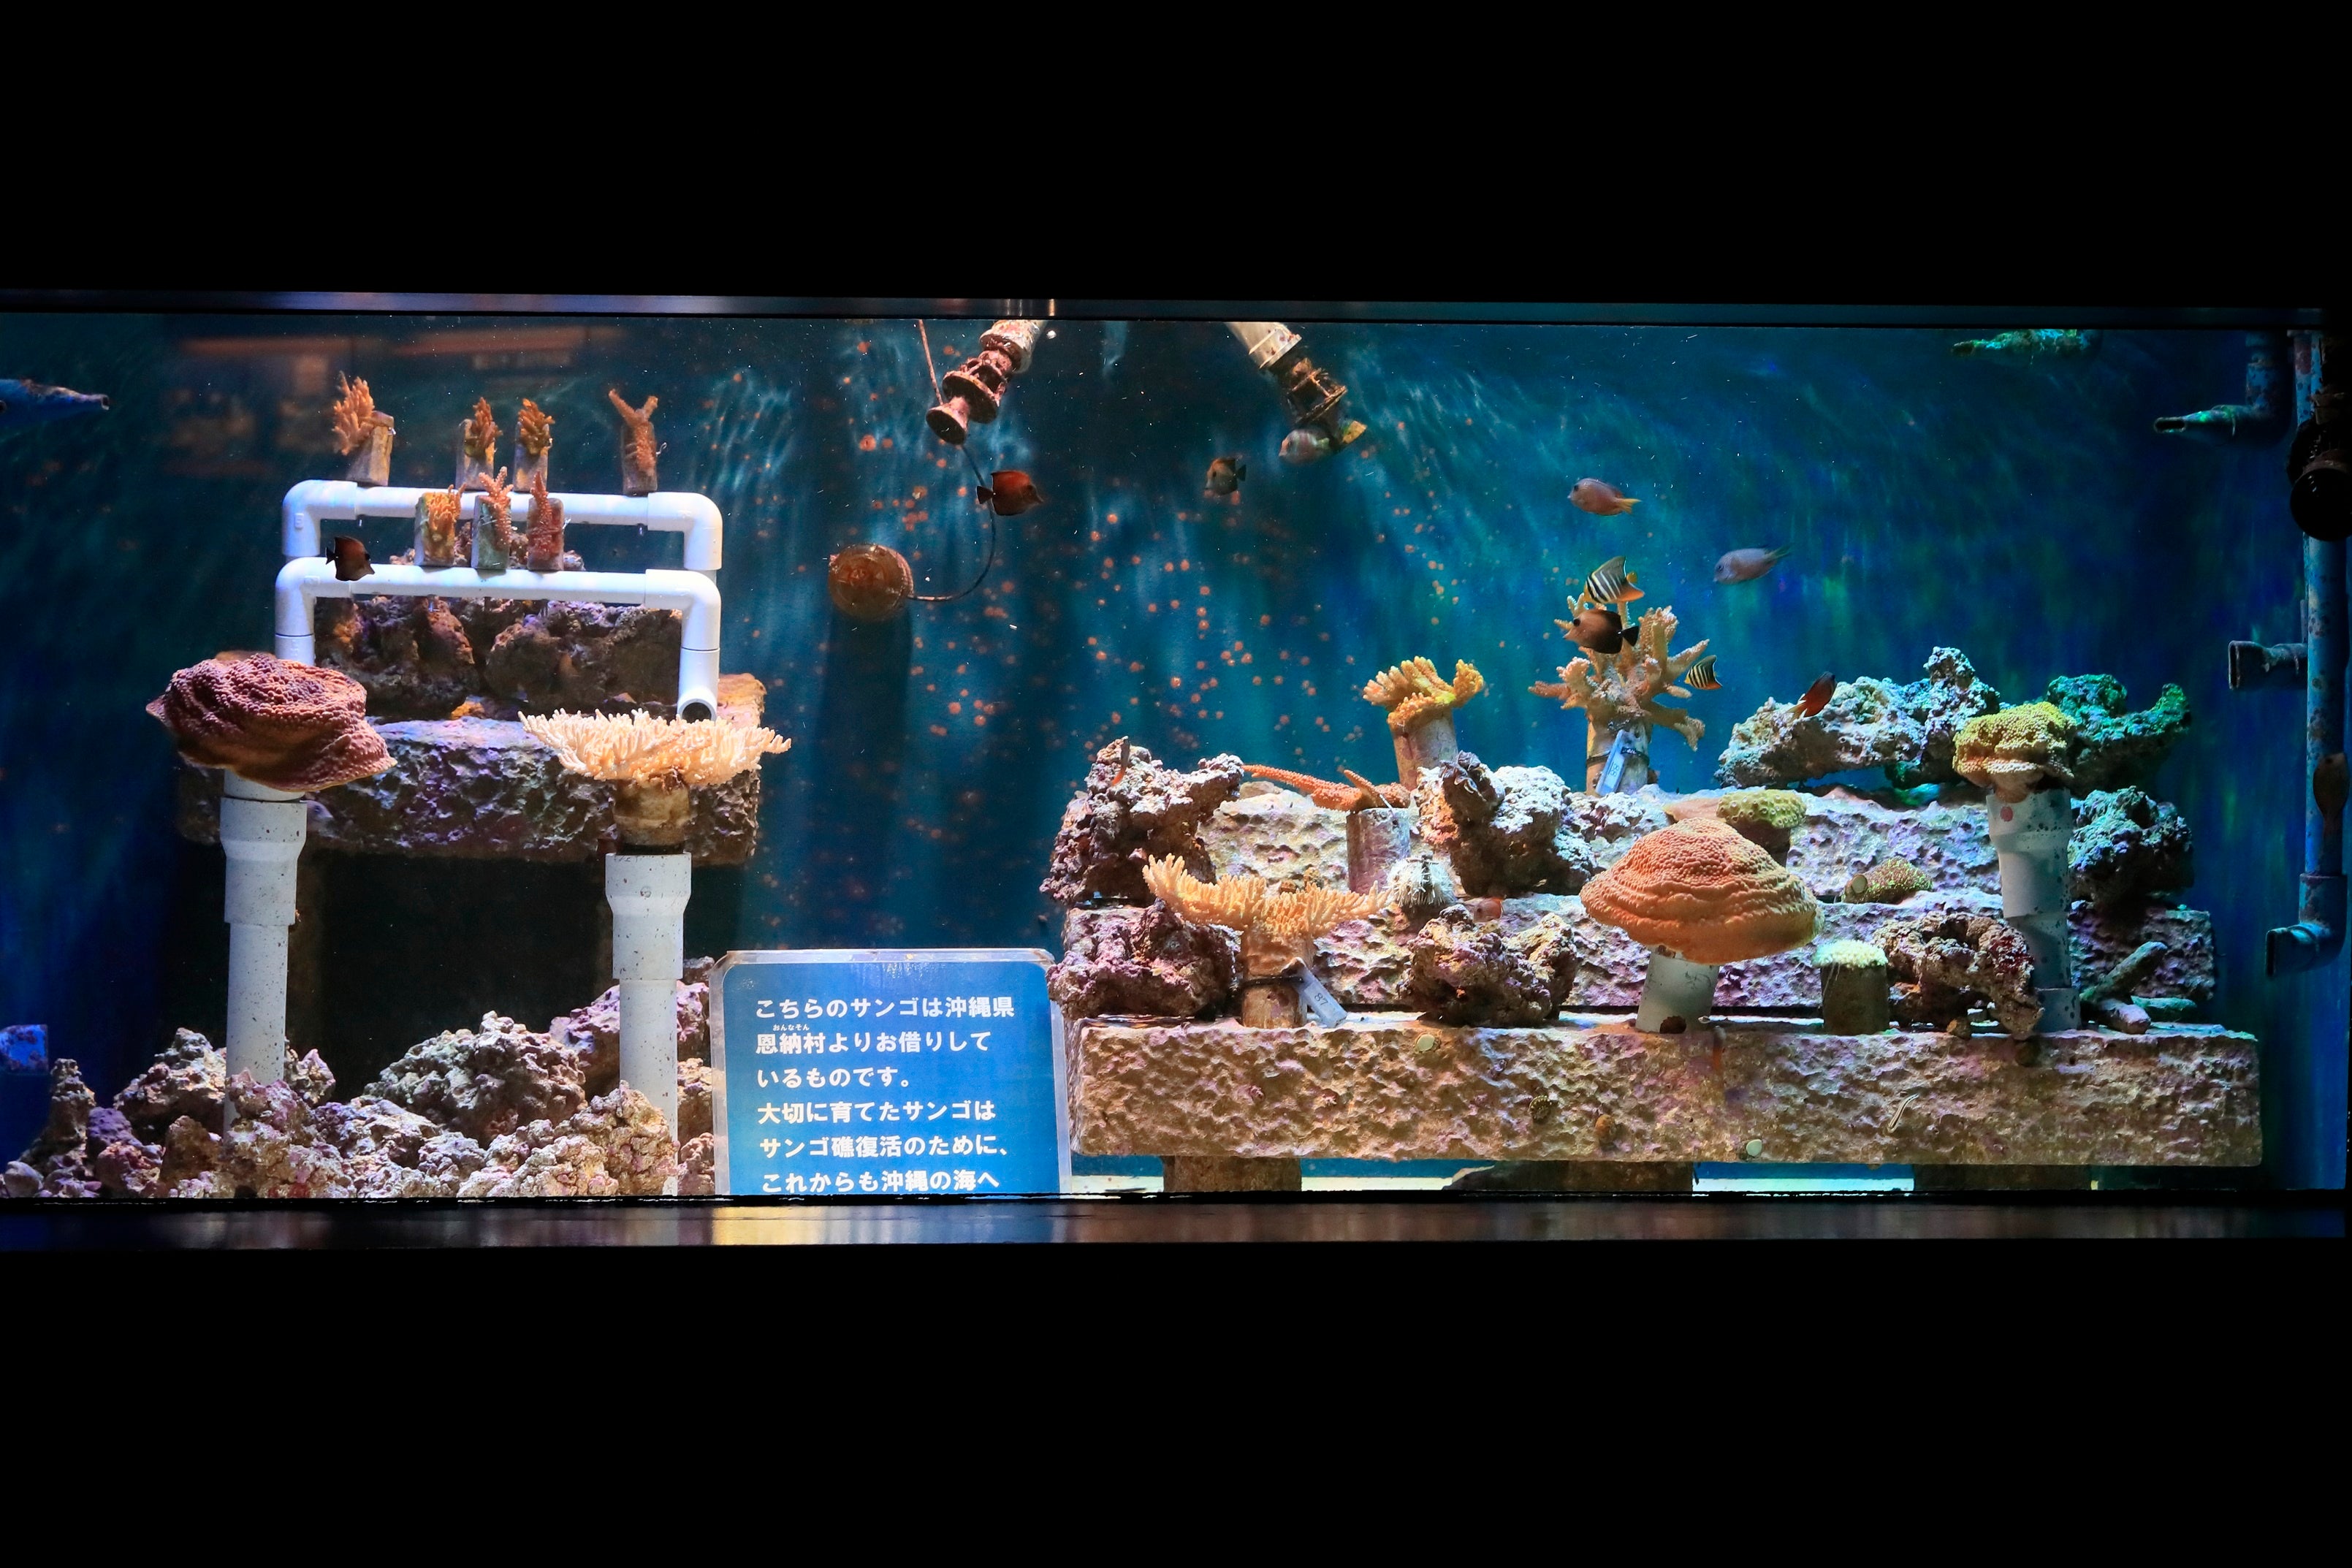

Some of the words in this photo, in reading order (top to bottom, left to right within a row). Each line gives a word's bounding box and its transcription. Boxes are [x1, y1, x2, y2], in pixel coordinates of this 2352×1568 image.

[756, 996, 1015, 1019] こちらのサンゴは沖縄県
[1314, 993, 1328, 1005] 87
[756, 1031, 992, 1054] 恩納村よりお借りして
[757, 1067, 909, 1088] いるものです。
[757, 1100, 996, 1124] 大切に育てたサンゴは
[759, 1134, 1008, 1159] サンゴ礁復活のために、
[762, 1169, 1000, 1193] これからも沖縄の海へ
